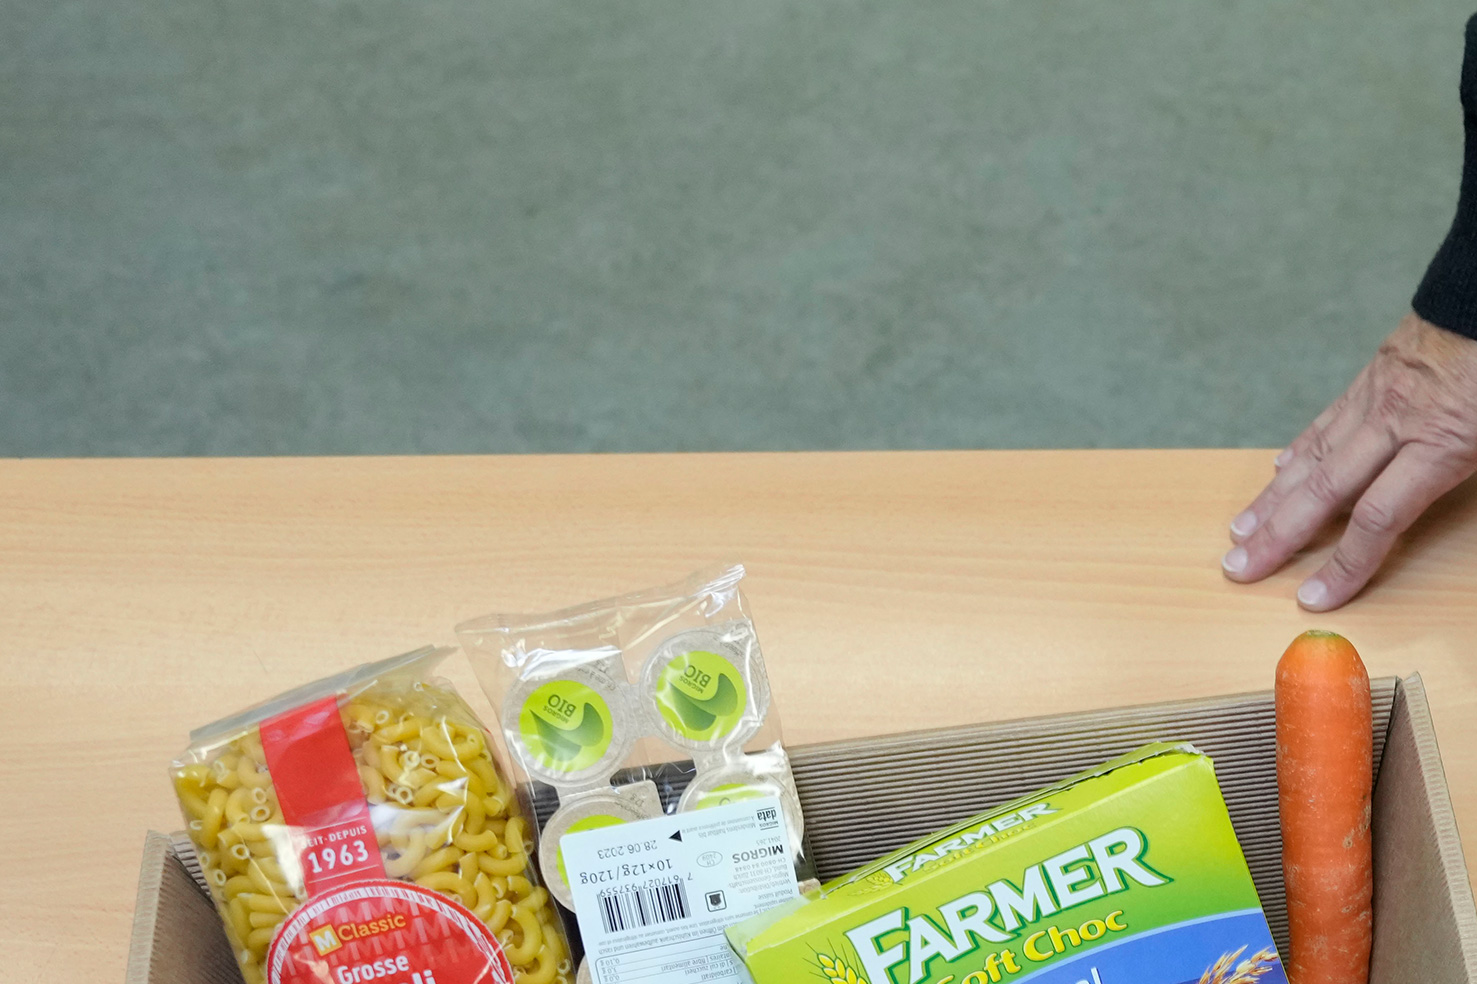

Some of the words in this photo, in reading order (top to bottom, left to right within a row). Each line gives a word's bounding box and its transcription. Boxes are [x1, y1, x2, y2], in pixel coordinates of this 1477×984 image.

[683, 663, 712, 689] BIO
[546, 693, 577, 718] BIO
[756, 808, 777, 823] data
[327, 824, 368, 842] DEPUIS
[888, 800, 1064, 885] FARMER
[306, 838, 370, 875] 1963
[595, 838, 658, 861] 28.06.2023
[730, 843, 784, 864] MIGROS
[598, 881, 637, 897] 937559
[641, 873, 680, 889] 617027
[337, 913, 407, 942] Classic
[1021, 908, 1130, 964] Choc
